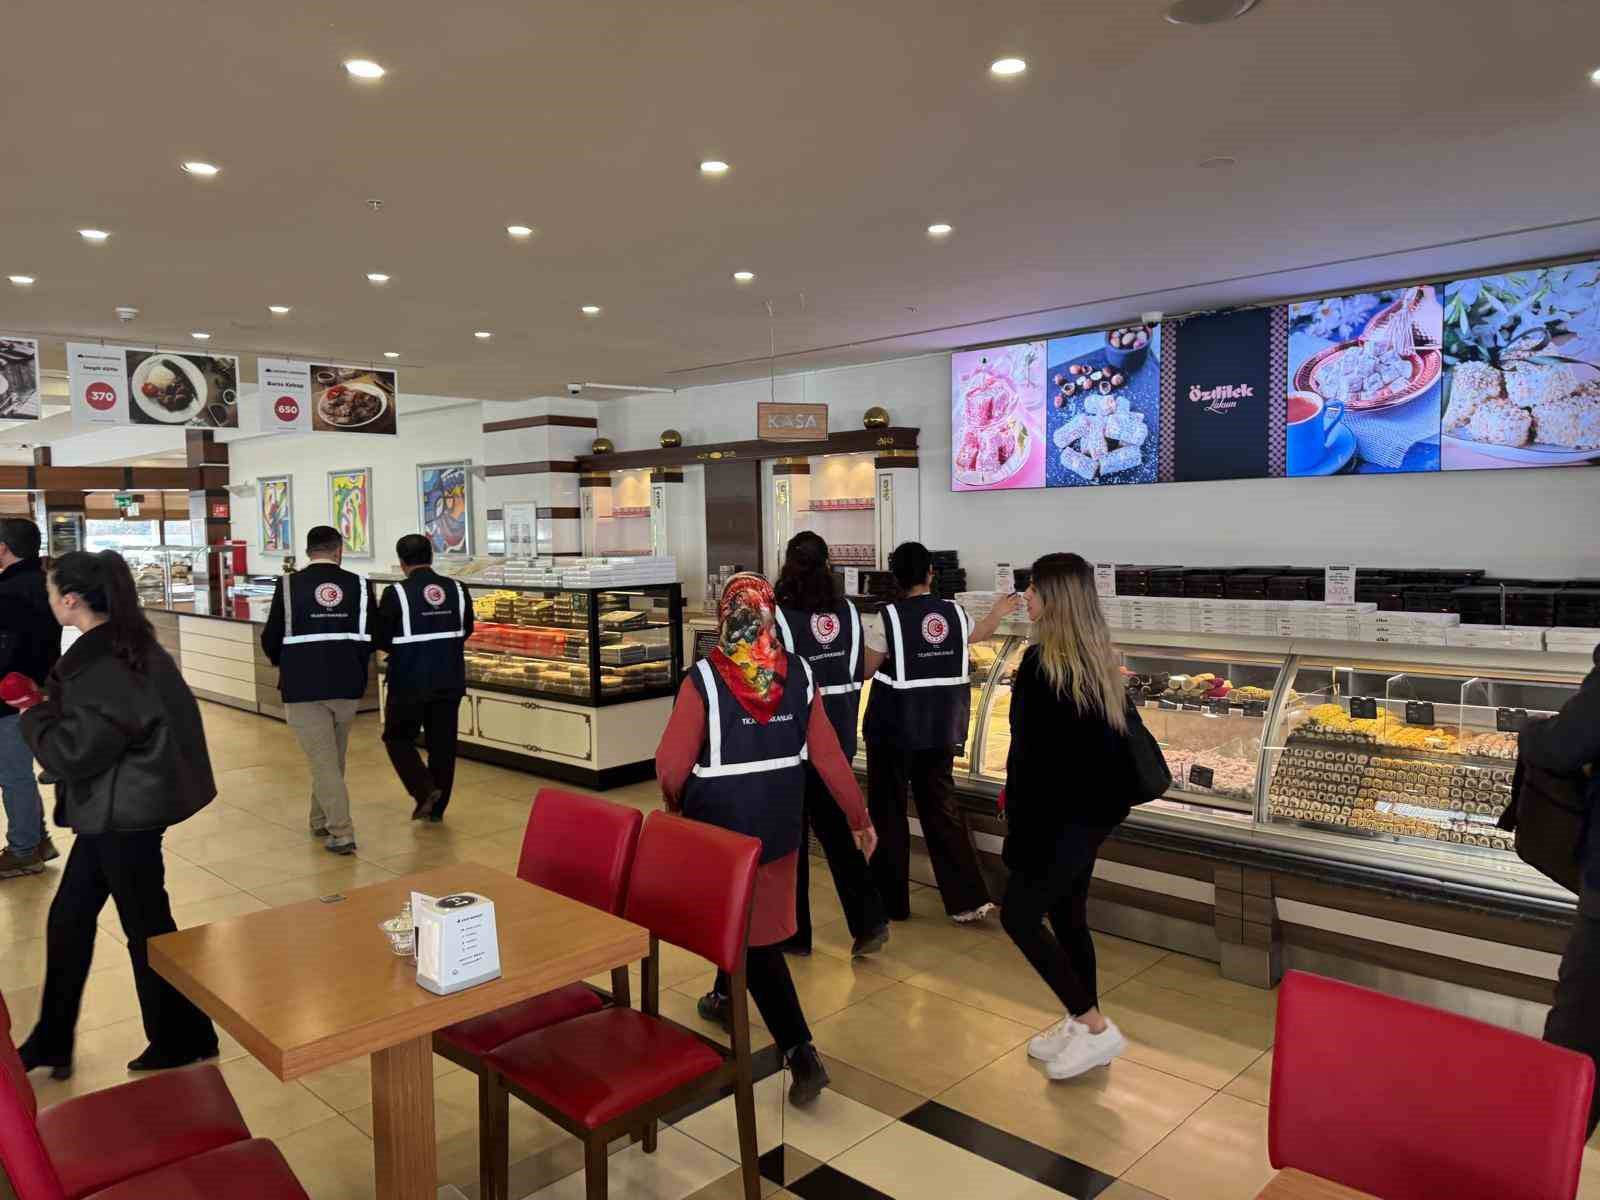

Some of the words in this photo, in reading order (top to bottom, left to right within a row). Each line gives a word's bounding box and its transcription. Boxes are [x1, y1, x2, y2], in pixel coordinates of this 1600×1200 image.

[91, 391, 114, 402] 370
[1189, 384, 1254, 402] Özdilek
[278, 405, 298, 414] 650
[768, 413, 817, 429] KASA
